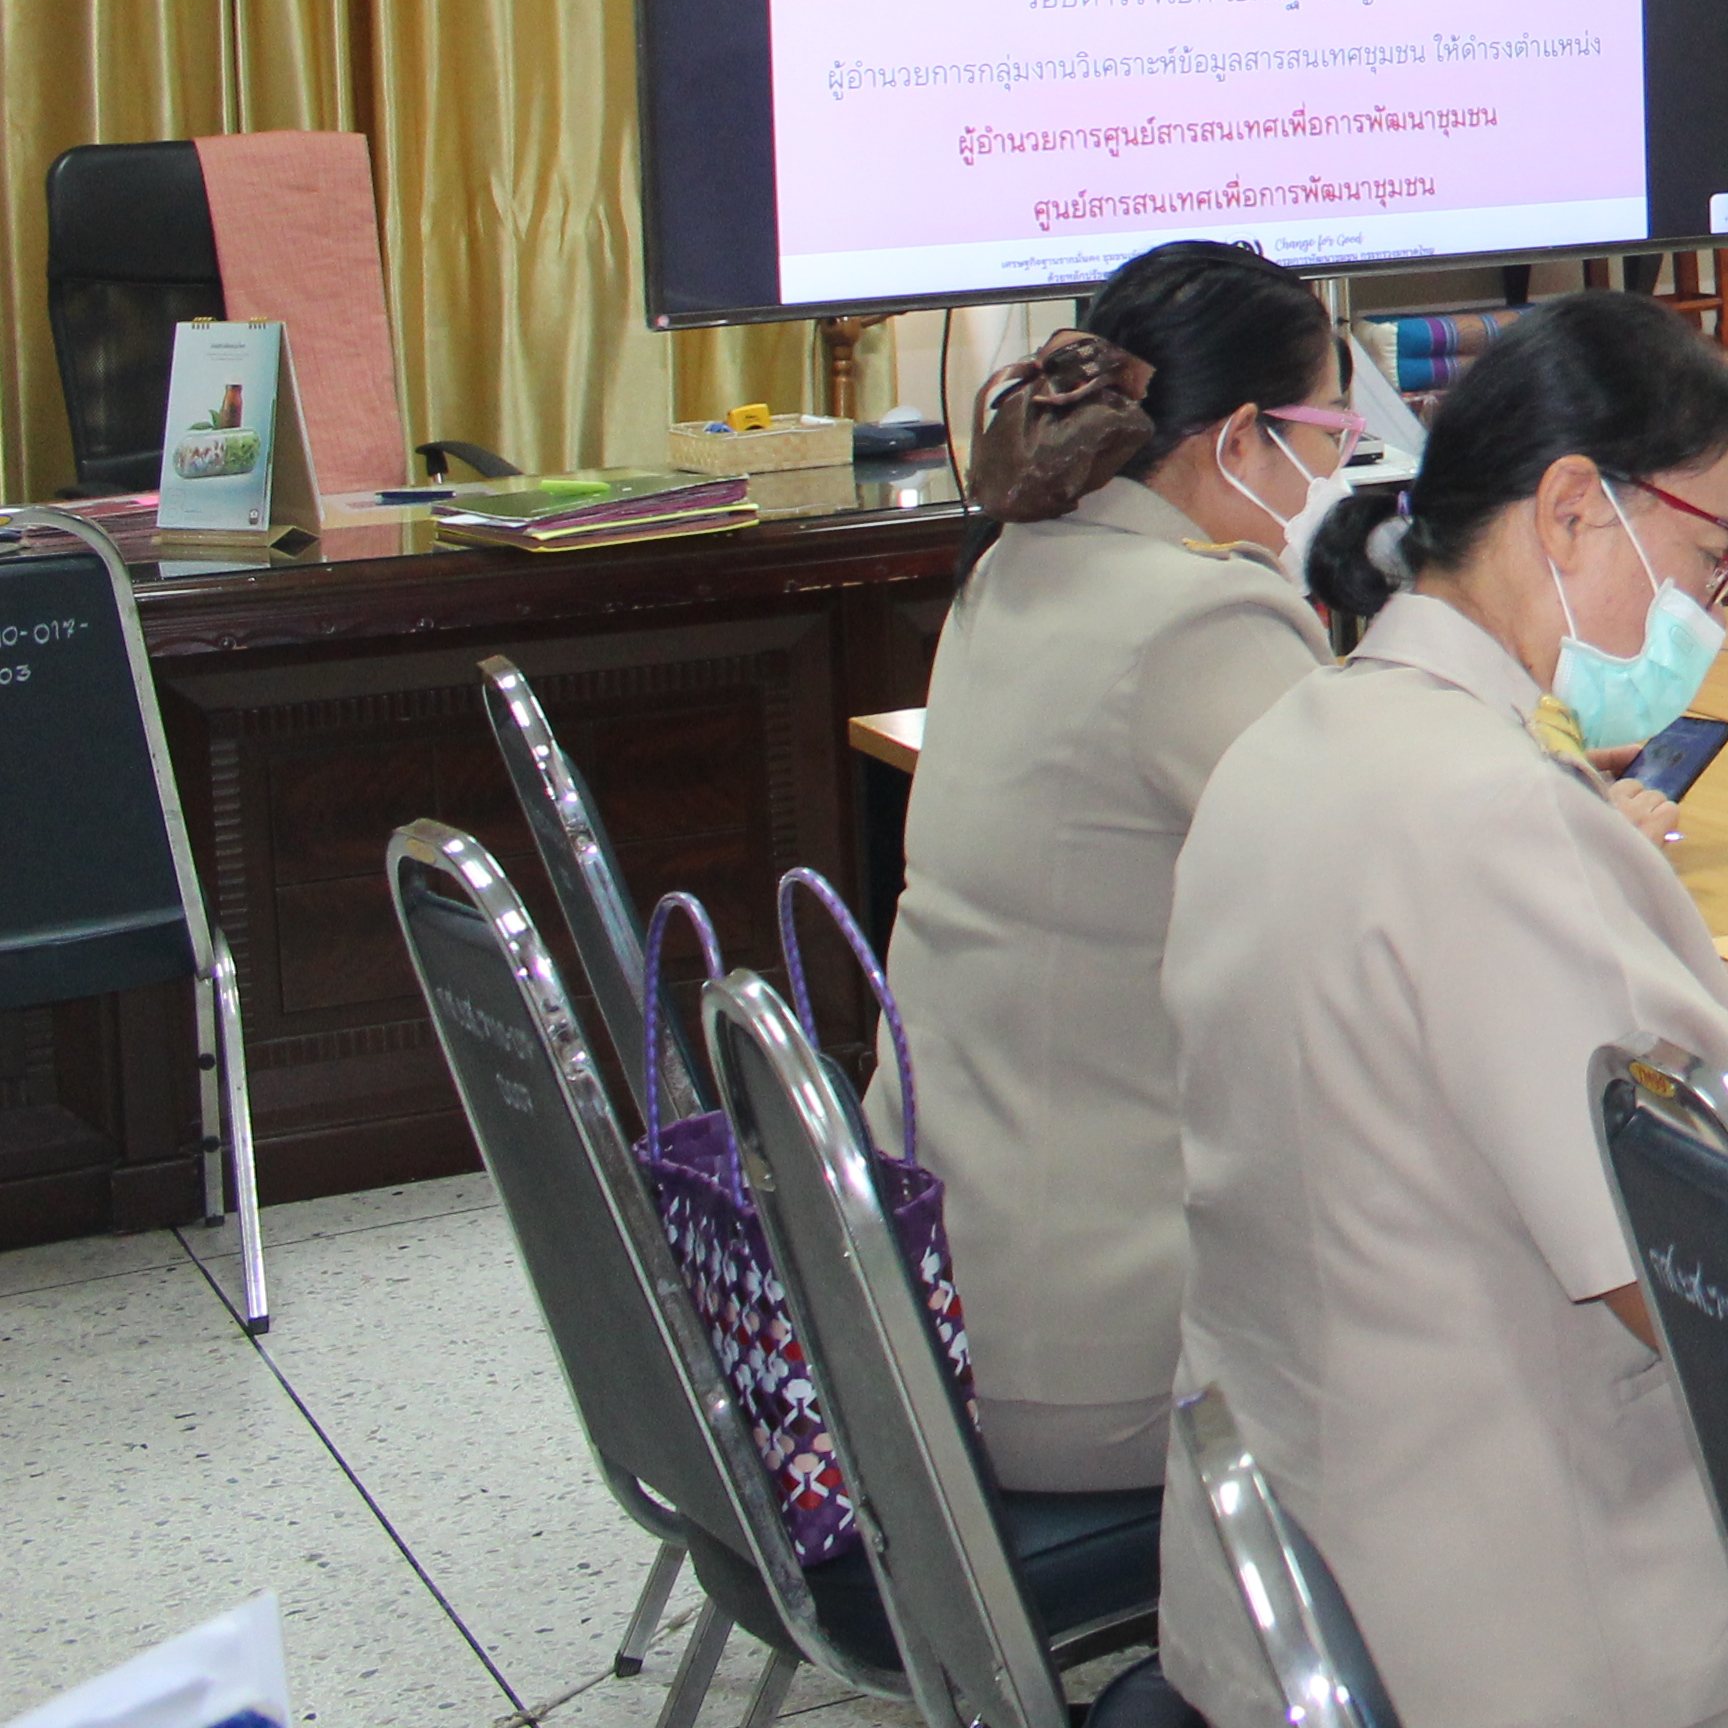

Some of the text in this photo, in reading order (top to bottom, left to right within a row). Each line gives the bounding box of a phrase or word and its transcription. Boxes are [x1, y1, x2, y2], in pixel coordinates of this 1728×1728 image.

[828, 30, 1602, 101] ผู้อำนวยการกลุ่มงานวิเคราะห์ข้อมูลสารสนเทศชุมชน ให้ดำรงตำแหน่ง
[958, 102, 1498, 165] ผู้อำนวยการศูนย์สารสนเทศเพื่อการพัฒนาชุมชน
[1033, 173, 1436, 231] ศูนย์สารสนเทศเพื่อการพัฒนาชุมชน
[1274, 232, 1364, 252] Change for Good
[0, 618, 88, 647] 0-017-
